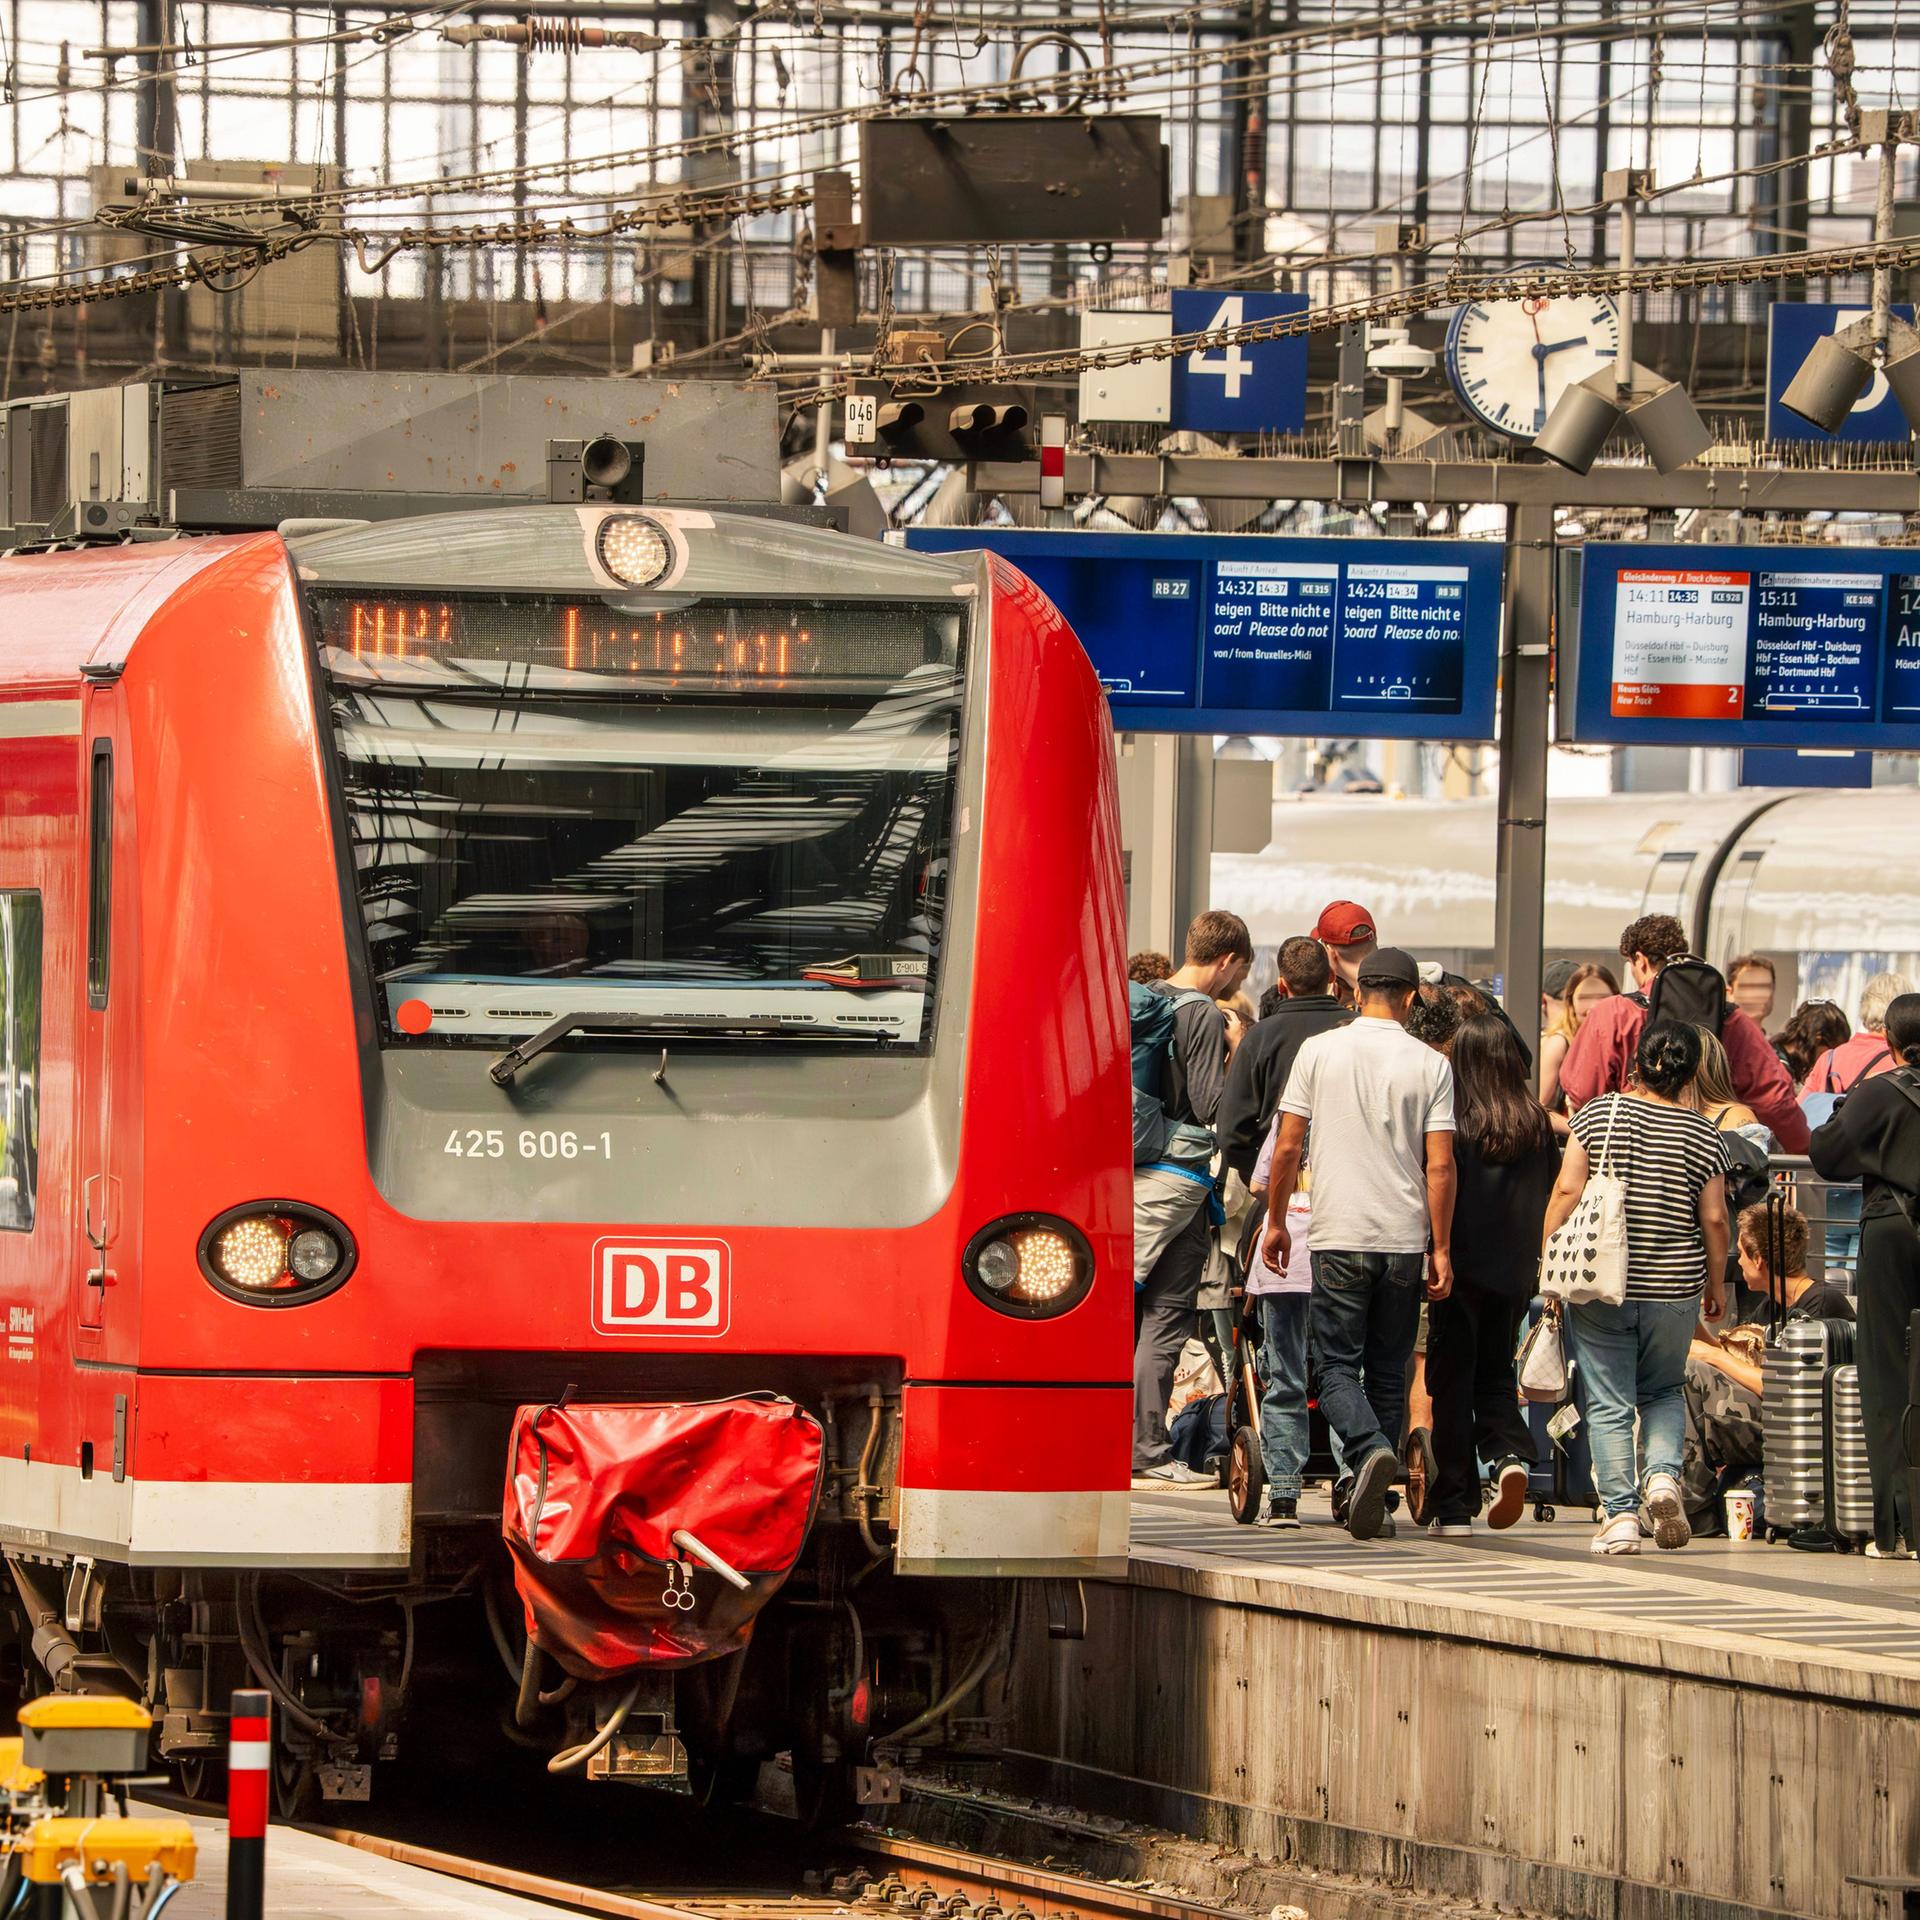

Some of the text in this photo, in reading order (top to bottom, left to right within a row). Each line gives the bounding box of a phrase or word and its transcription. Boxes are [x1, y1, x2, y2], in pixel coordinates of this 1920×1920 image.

[1188, 296, 1253, 398] 4
[850, 404, 872, 421] 046
[1155, 582, 1187, 596] RB 27
[1217, 580, 1255, 596] 14:32
[1259, 583, 1286, 594] 14:37
[1347, 584, 1385, 598] 14:24
[1390, 586, 1416, 597] 14:34
[1628, 590, 1664, 603] 14:11
[1669, 591, 1698, 602] 14:36
[1713, 593, 1725, 601] ICE
[1760, 592, 1798, 606] 15:11
[1215, 602, 1330, 619] teigen Bitte nicht e
[1345, 605, 1460, 622] teigen Bitte nicht e
[1626, 610, 1733, 628] Hamburg-Harburg
[1758, 612, 1866, 632] Hamburg-Harburg
[1214, 621, 1328, 638] oard Please do not
[1384, 624, 1423, 640] Please
[1425, 626, 1440, 640] do
[1442, 628, 1460, 640] no
[1214, 650, 1228, 658] von
[1235, 648, 1254, 659] from
[1255, 649, 1312, 660] Bruxelles-Midi
[1692, 642, 1729, 653] Duisburg
[1756, 640, 1800, 650] Düsseldorf
[1801, 640, 1817, 651] Hbf
[1825, 641, 1861, 654] Duisburg
[1648, 654, 1670, 664] Essen
[1756, 653, 1771, 663] Hbf
[1779, 653, 1803, 664] Essen
[1804, 654, 1819, 664] Hbf
[1827, 654, 1860, 665] Bochum
[1755, 666, 1771, 676] Hbf
[1779, 666, 1819, 677] Dortmund
[1820, 667, 1836, 677] Hbf
[1728, 687, 1738, 704] 2
[444, 1130, 612, 1160] 425 606-1
[610, 1254, 714, 1320] DB
